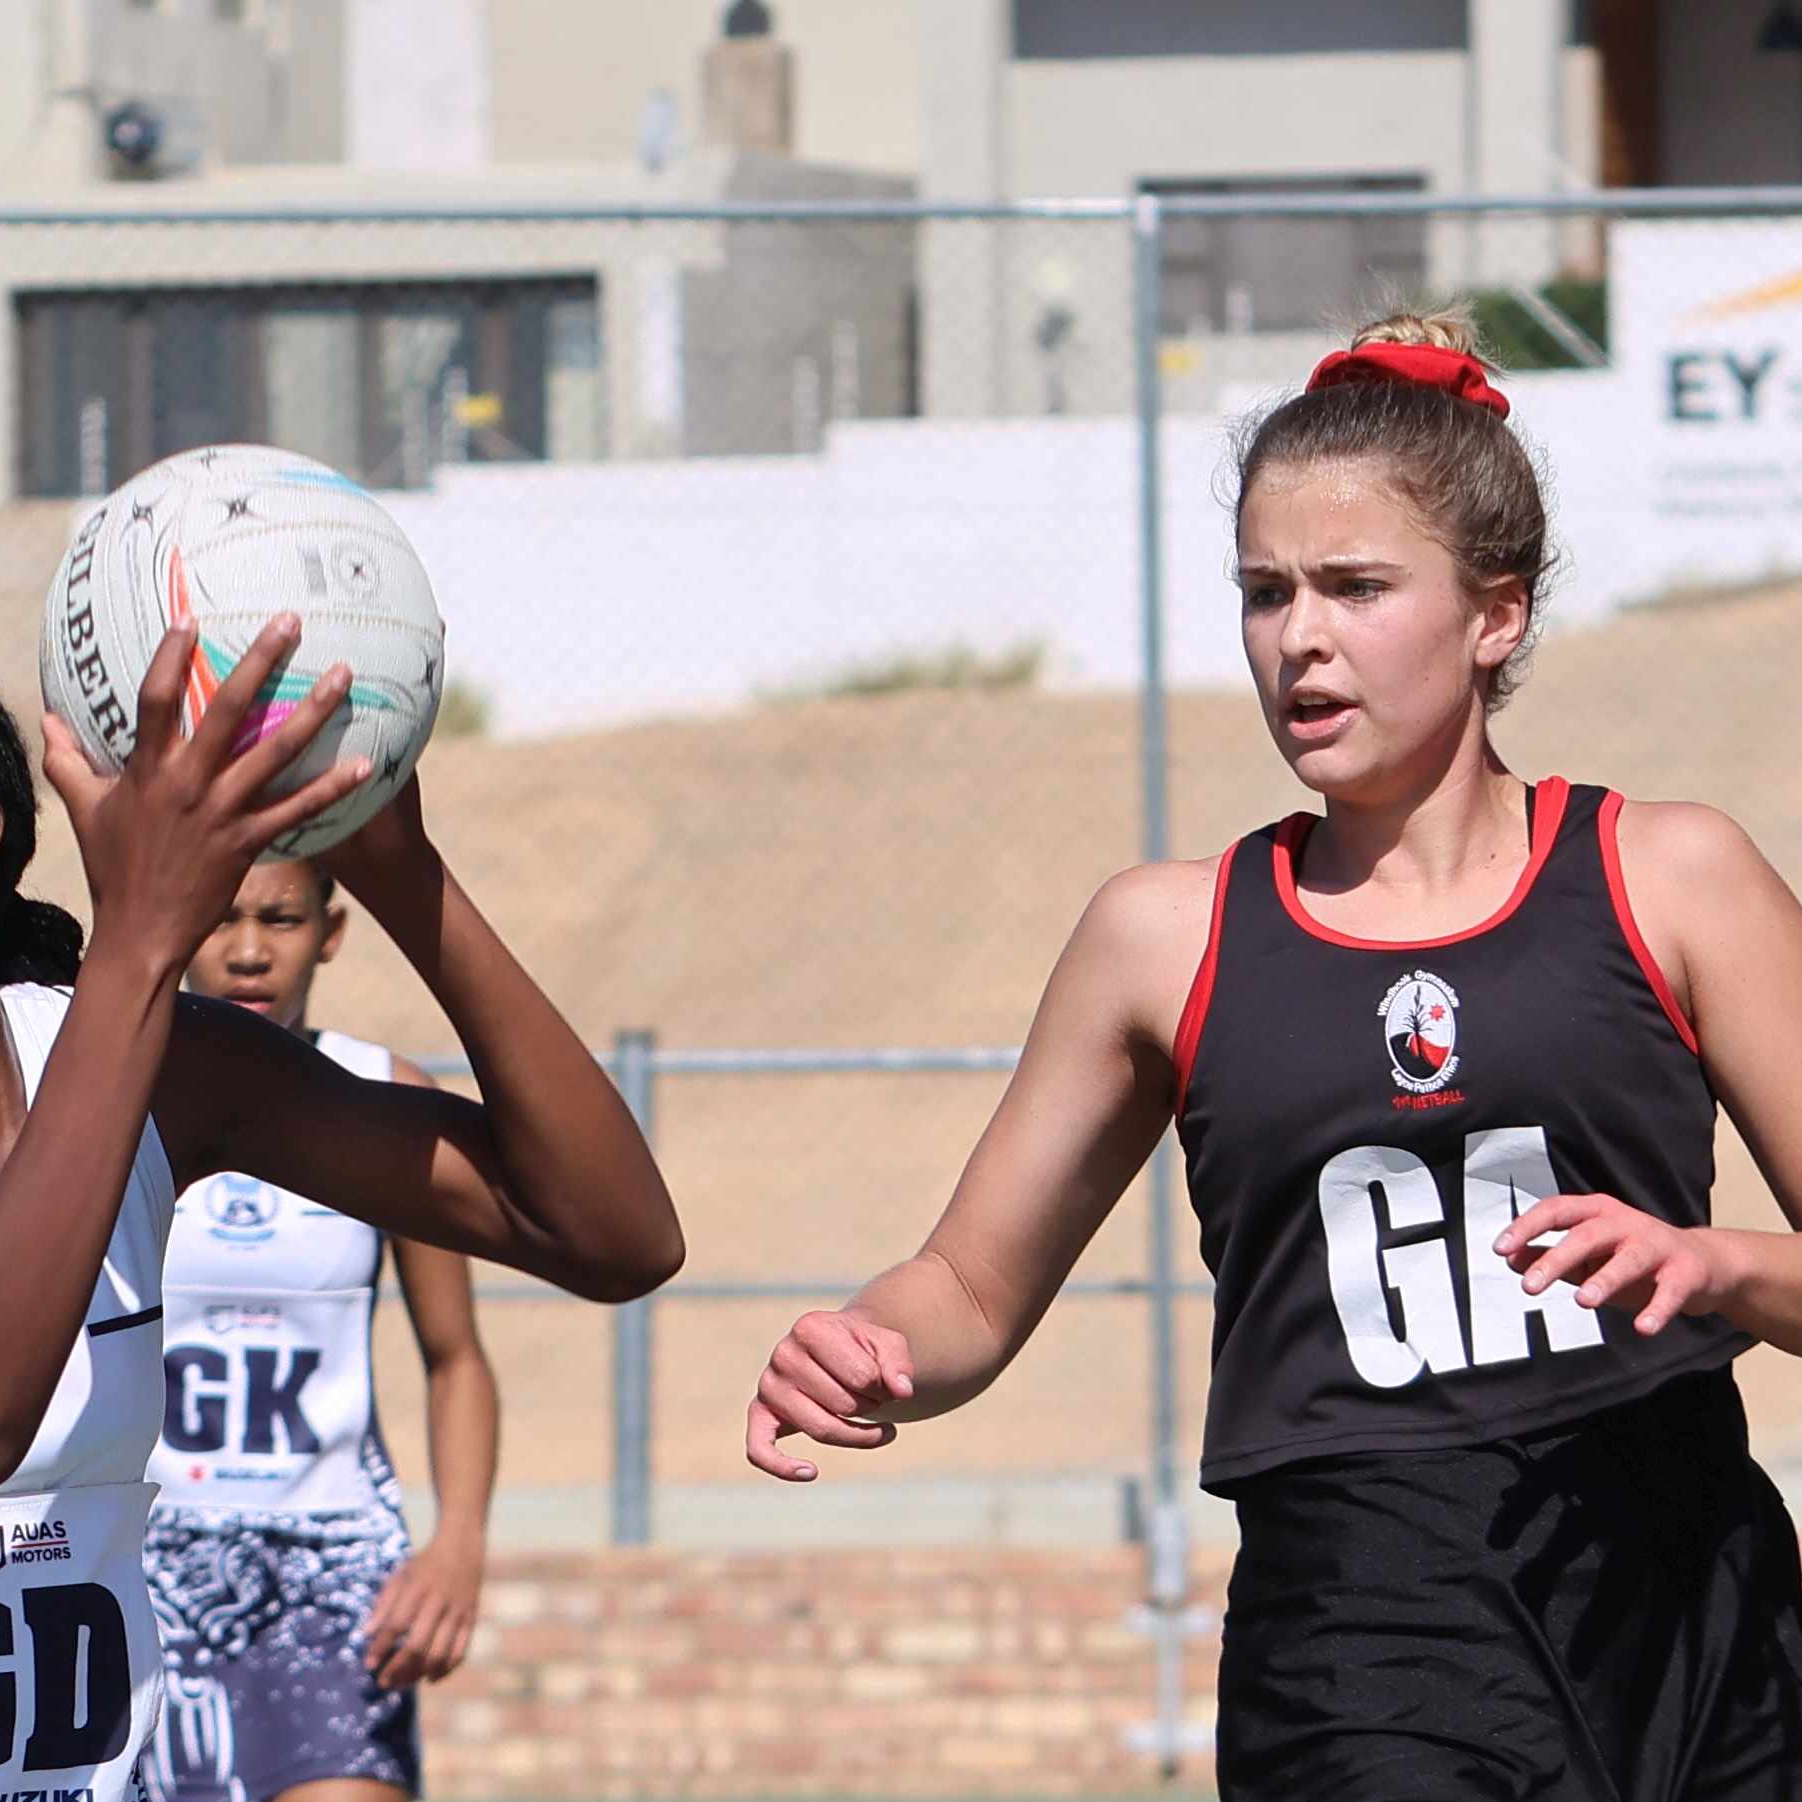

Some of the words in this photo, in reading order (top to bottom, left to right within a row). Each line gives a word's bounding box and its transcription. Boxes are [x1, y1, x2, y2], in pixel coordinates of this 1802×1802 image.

[1665, 348, 1778, 422] EY
[67, 508, 137, 765] GILBER
[1318, 1126, 1605, 1388] GA
[163, 1346, 322, 1454] GK
[10, 1520, 67, 1543] AUAS
[11, 1546, 71, 1565] MOTORS
